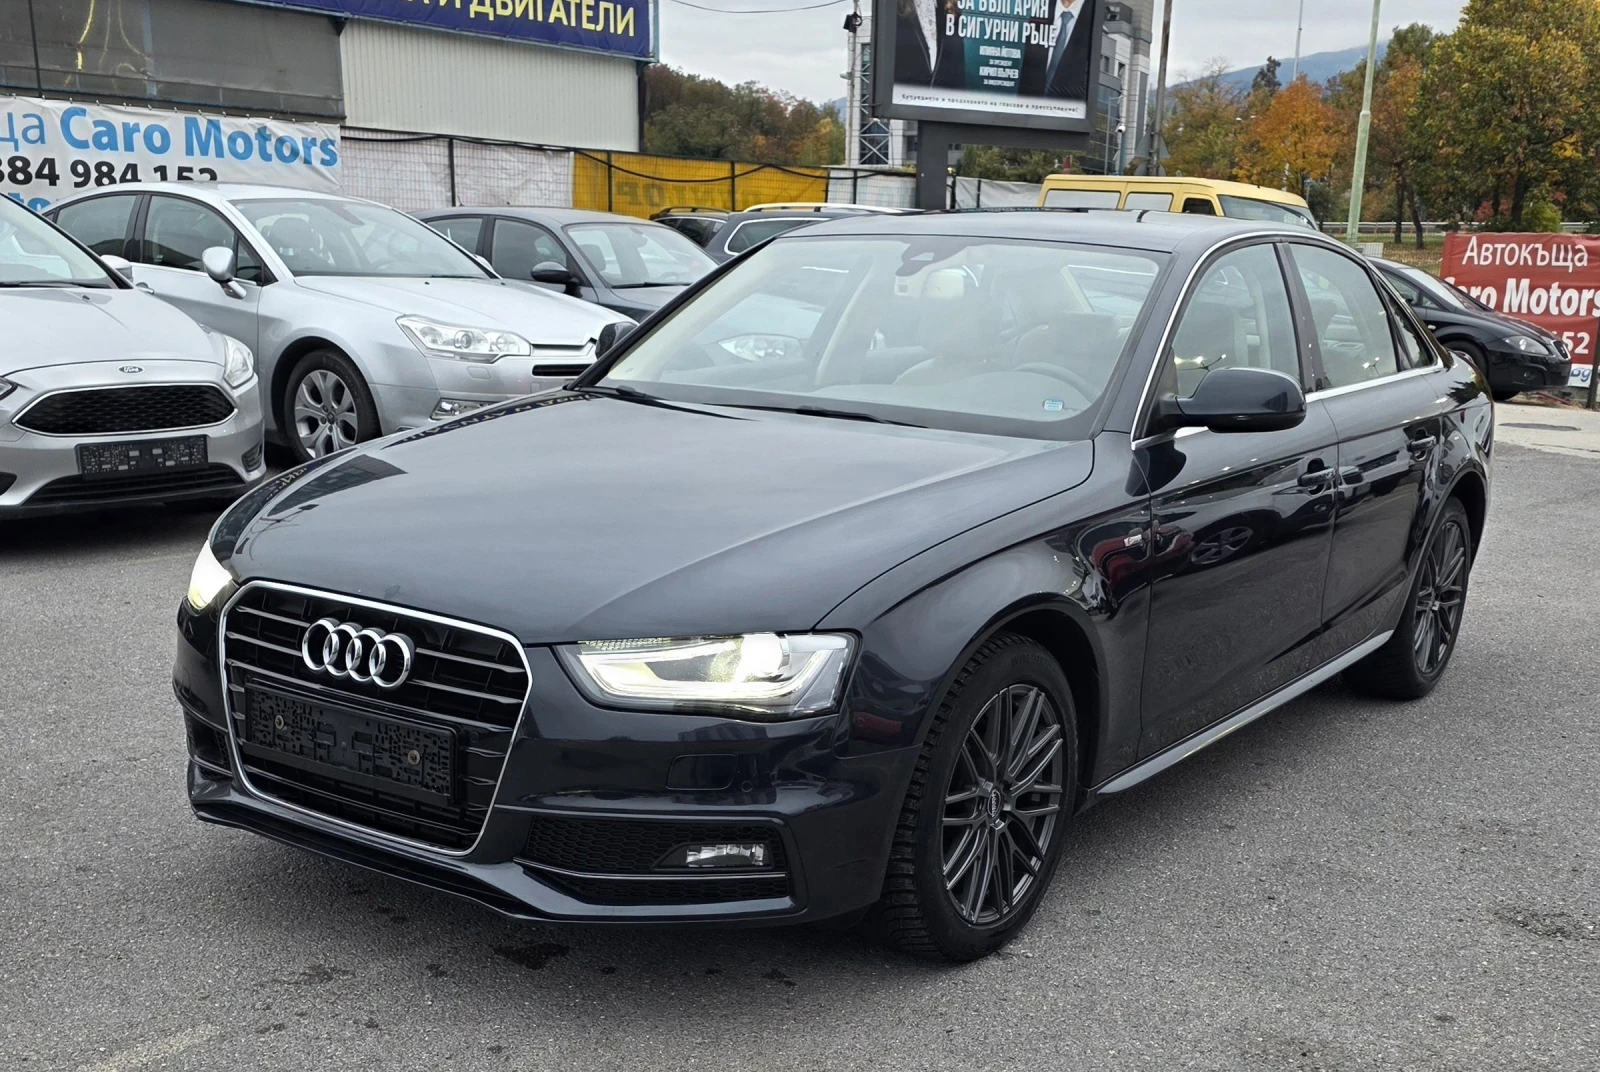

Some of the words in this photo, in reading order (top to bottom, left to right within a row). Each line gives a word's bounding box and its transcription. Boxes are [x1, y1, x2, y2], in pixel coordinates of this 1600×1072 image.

[469, 0, 635, 37] ДВИГАТЕЛИ
[945, 13, 955, 36] В
[958, 15, 1019, 42] СИГУРНИ
[1021, 22, 1056, 48] РЪЦЕ
[60, 106, 171, 155] Caro
[184, 117, 338, 167] Motors
[0, 155, 60, 187] 84
[69, 159, 142, 188] 984
[1461, 235, 1589, 273] Автокъща
[1444, 276, 1498, 309] ro
[1502, 278, 1600, 318] Motors
